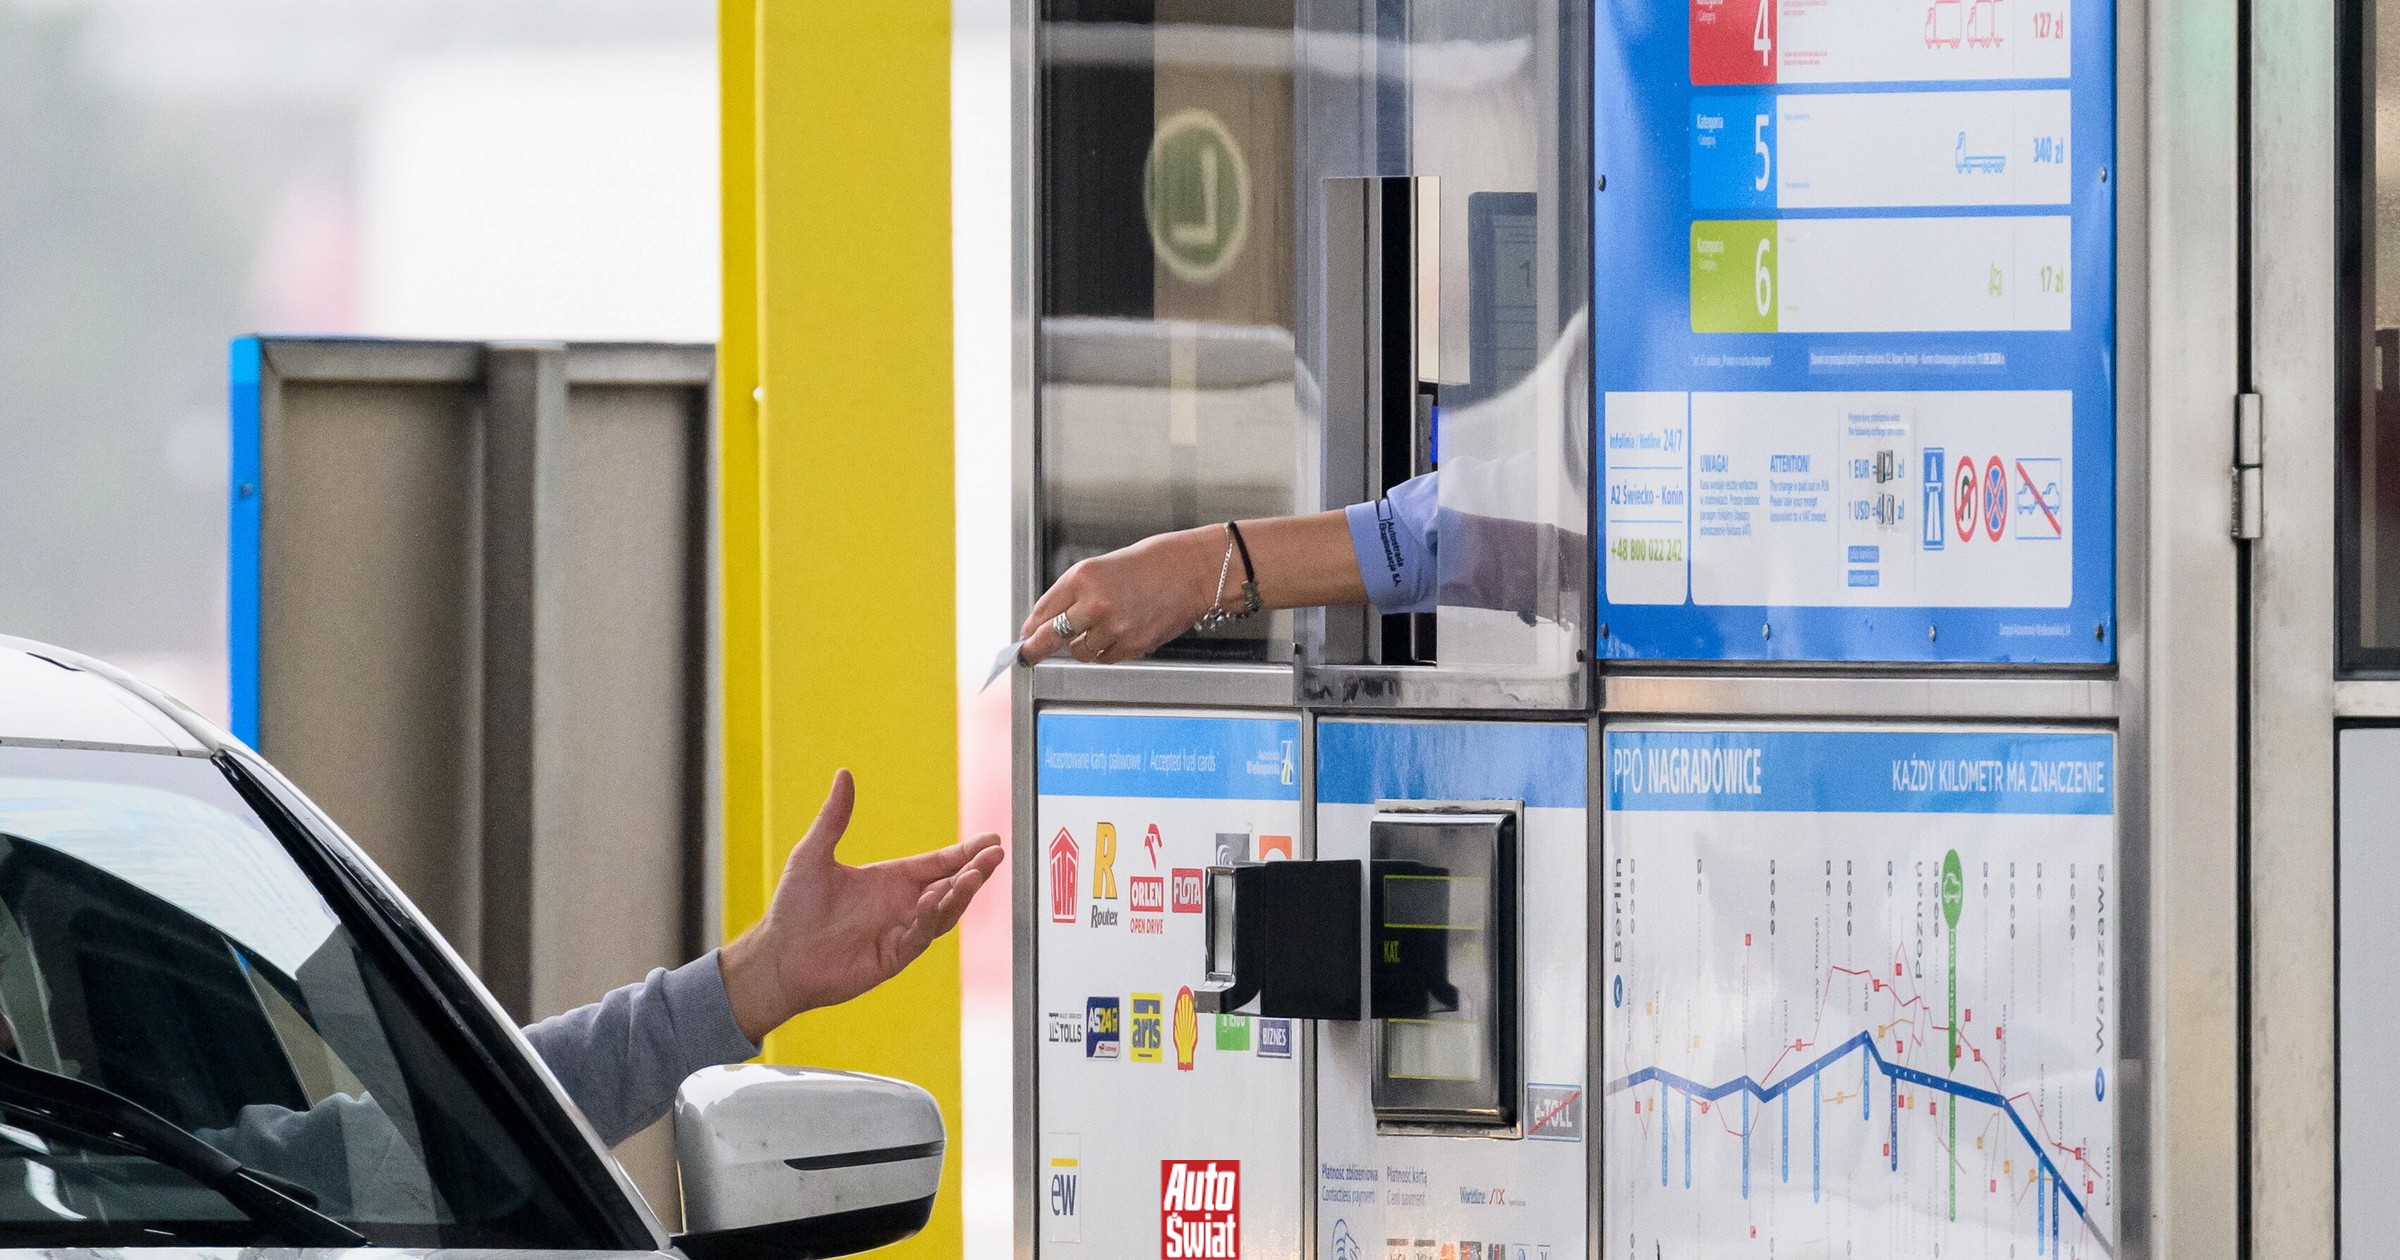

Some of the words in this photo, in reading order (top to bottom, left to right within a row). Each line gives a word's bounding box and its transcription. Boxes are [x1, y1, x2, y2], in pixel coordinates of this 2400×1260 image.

[1754, 0, 1771, 66] 4
[2033, 13, 2051, 38] 127
[1755, 115, 1770, 191] 5
[2032, 136, 2051, 163] 340
[1755, 238, 1771, 316] 6
[2040, 266, 2051, 292] 17
[1610, 432, 1634, 449] Infolinia
[1640, 432, 1661, 449] Hotline
[1664, 428, 1682, 452] 24/7
[1700, 454, 1728, 473] UWAGA!
[1770, 454, 1810, 473] ATTENTION!
[1854, 458, 1870, 479] EUR
[1610, 484, 1621, 505] A2
[1623, 479, 1655, 505] Świecko
[1662, 484, 1684, 505] Konin
[1854, 500, 1870, 520] USD
[1386, 521, 1405, 567] Autostrada
[1611, 538, 1628, 561] +48
[1630, 538, 1648, 561] 800
[1649, 538, 1665, 561] 022
[1667, 538, 1683, 561] 242
[1046, 746, 1090, 771] Akceptowane
[1091, 746, 1108, 775] karty
[1151, 748, 1182, 775] Accepted
[1182, 749, 1196, 772] fuel
[1197, 749, 1217, 773] cards
[1614, 748, 1643, 794] PPO
[1647, 748, 1762, 795] NAGRADOWICE
[1891, 753, 1935, 792] KAŻDY
[1938, 759, 2004, 793] KILOMETR
[2006, 760, 2026, 793] MA
[2029, 760, 2105, 794] ZNACZENIE
[1131, 881, 1163, 908] ORLEN
[1173, 876, 1202, 905] FLOTA
[1091, 905, 1119, 929] Routex
[1613, 857, 1623, 964] Berlin
[1914, 861, 1923, 980] Poznań
[1130, 918, 1146, 934] OPEN
[1147, 918, 1164, 935] DRIVE
[1384, 940, 1400, 962] KAT.
[2095, 863, 2105, 1054] Warszawa
[1060, 1022, 1082, 1042] TOLLS
[1262, 1027, 1287, 1046] BIZNES
[1534, 1098, 1573, 1128] e-TOLL
[1322, 1185, 1351, 1203] Contactless
